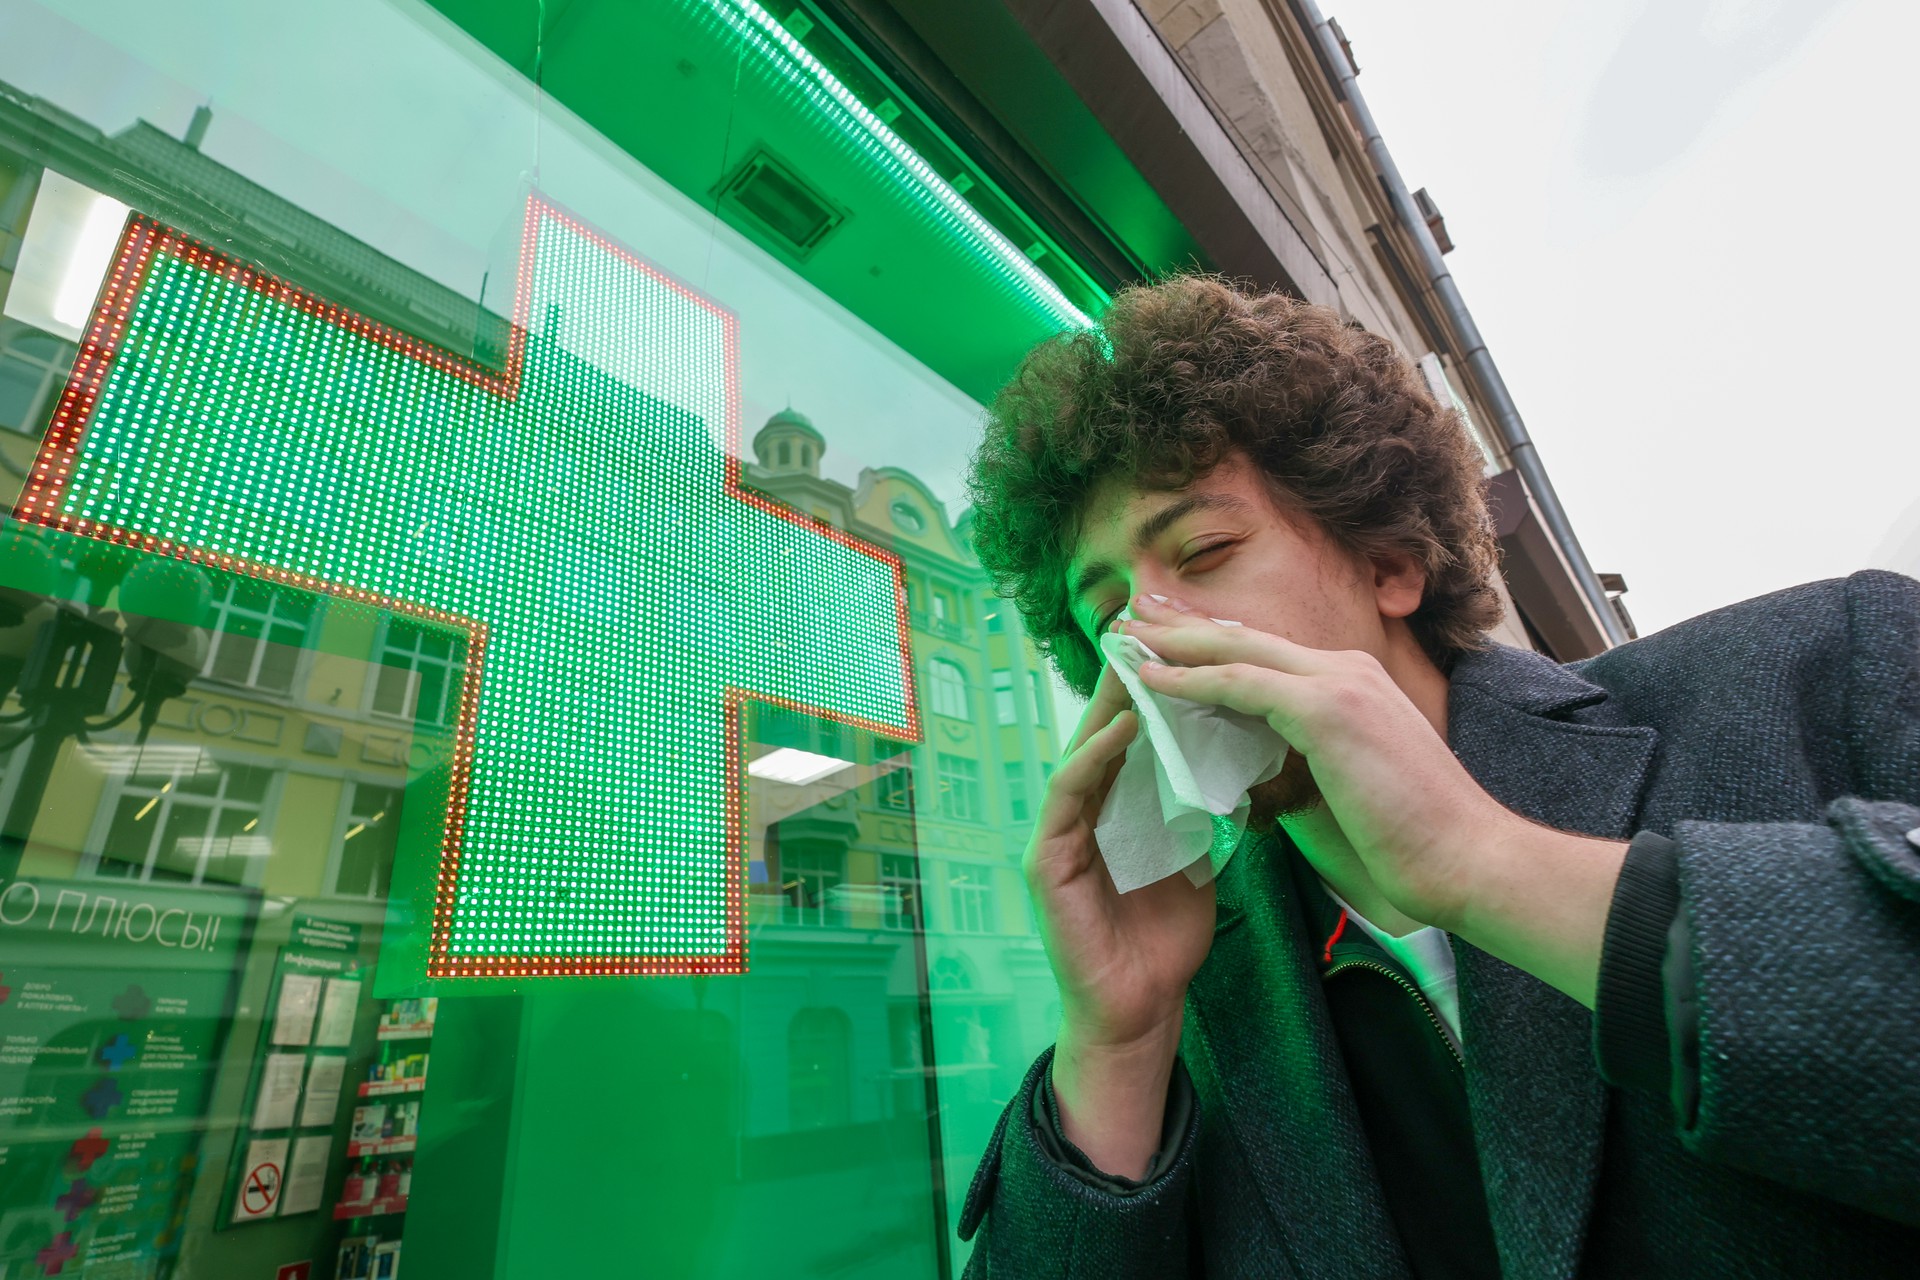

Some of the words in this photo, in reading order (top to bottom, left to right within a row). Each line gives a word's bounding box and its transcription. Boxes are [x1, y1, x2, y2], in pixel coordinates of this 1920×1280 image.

[0, 878, 40, 926] О
[48, 889, 222, 953] ПЛЮСЫ!
[283, 952, 341, 971] Информация
